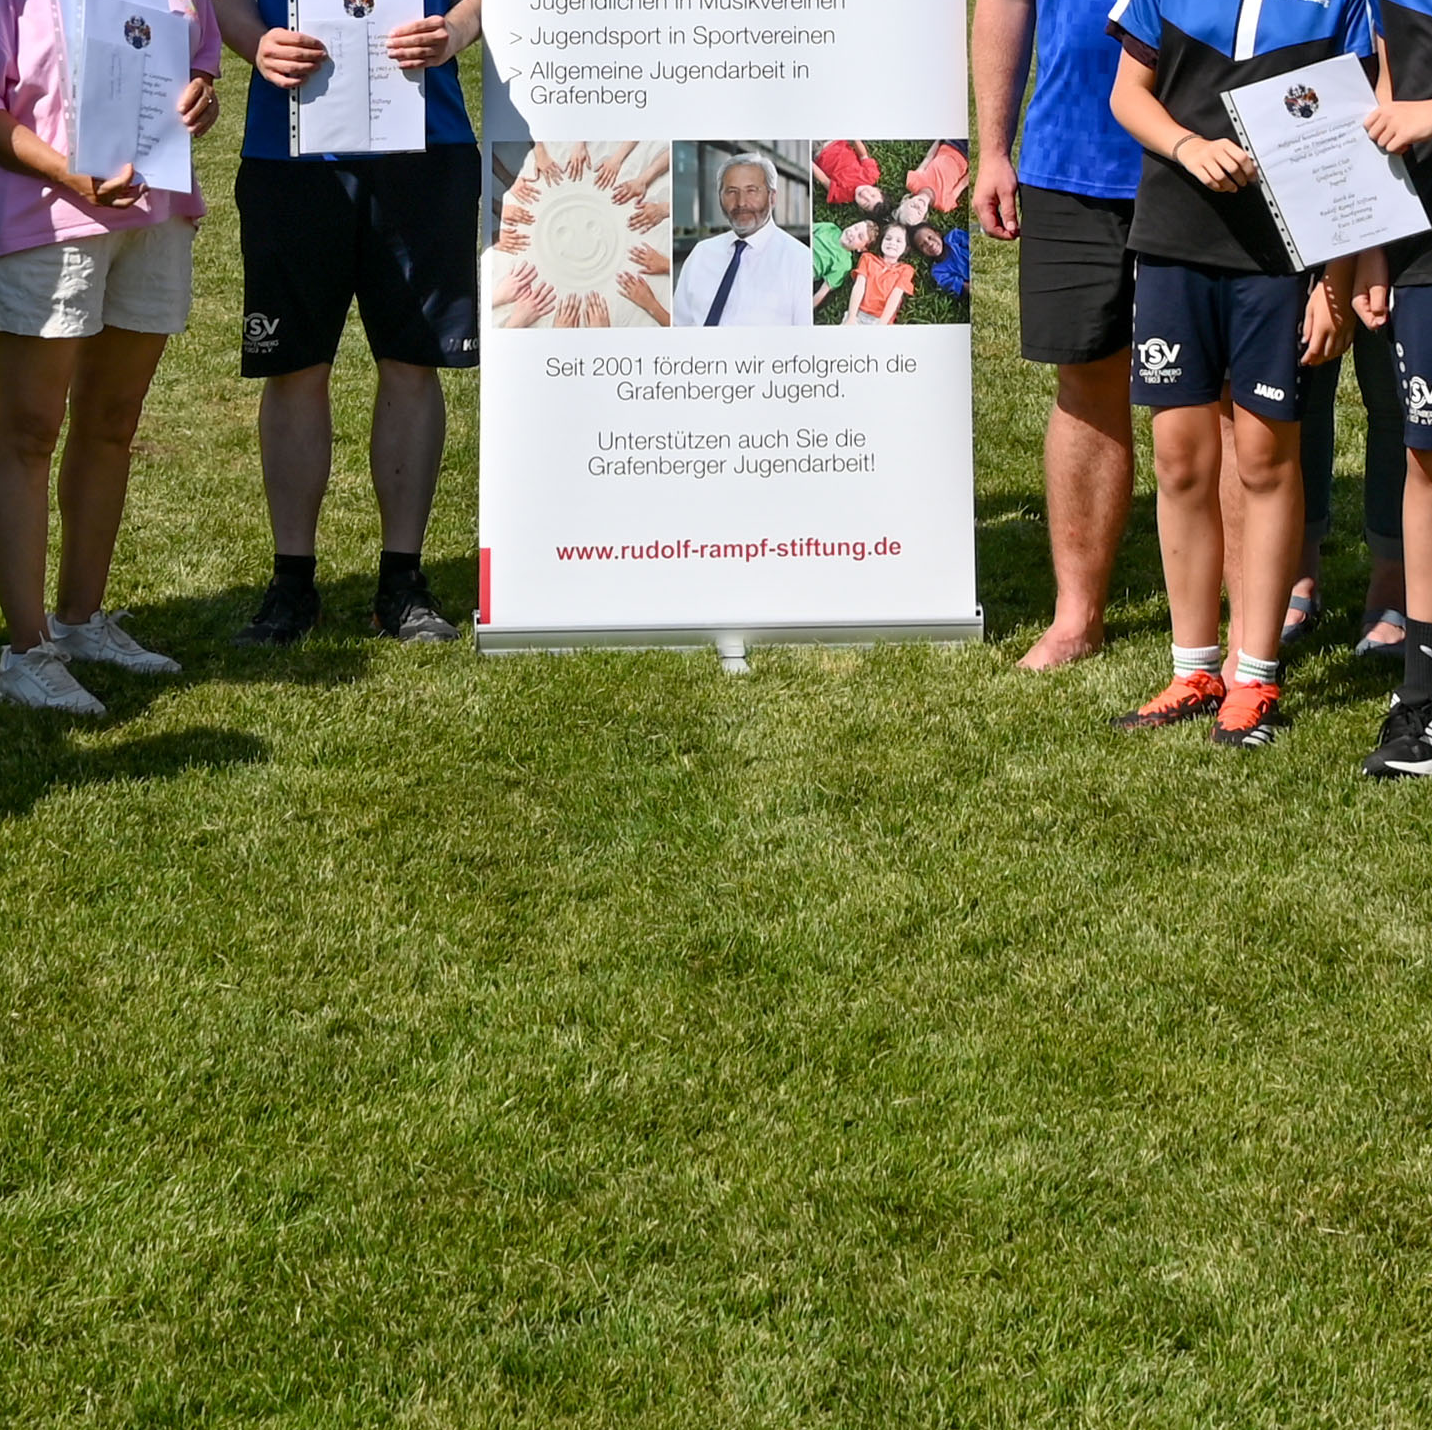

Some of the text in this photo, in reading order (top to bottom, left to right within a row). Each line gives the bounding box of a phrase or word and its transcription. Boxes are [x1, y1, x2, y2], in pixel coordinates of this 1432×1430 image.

[530, 26, 836, 50] Jugendsport in Sportvereinen
[530, 61, 809, 85] Allgemeine Jugendarbeit in
[530, 85, 648, 109] Grafenberg
[1138, 343, 1181, 364] TSV
[545, 354, 917, 379] Seit 2001 fördern wir erfolgreich die
[1139, 368, 1182, 377] GRAFENBERG
[616, 380, 846, 404] Grafenberger Jugend.
[1253, 382, 1285, 401] JAKO
[597, 429, 866, 451] Unterstützen auch Sie die
[588, 454, 875, 478] Grafenberger Jugendarbeit!
[556, 537, 902, 562] www.rudolf-rampf-stiftung.de
